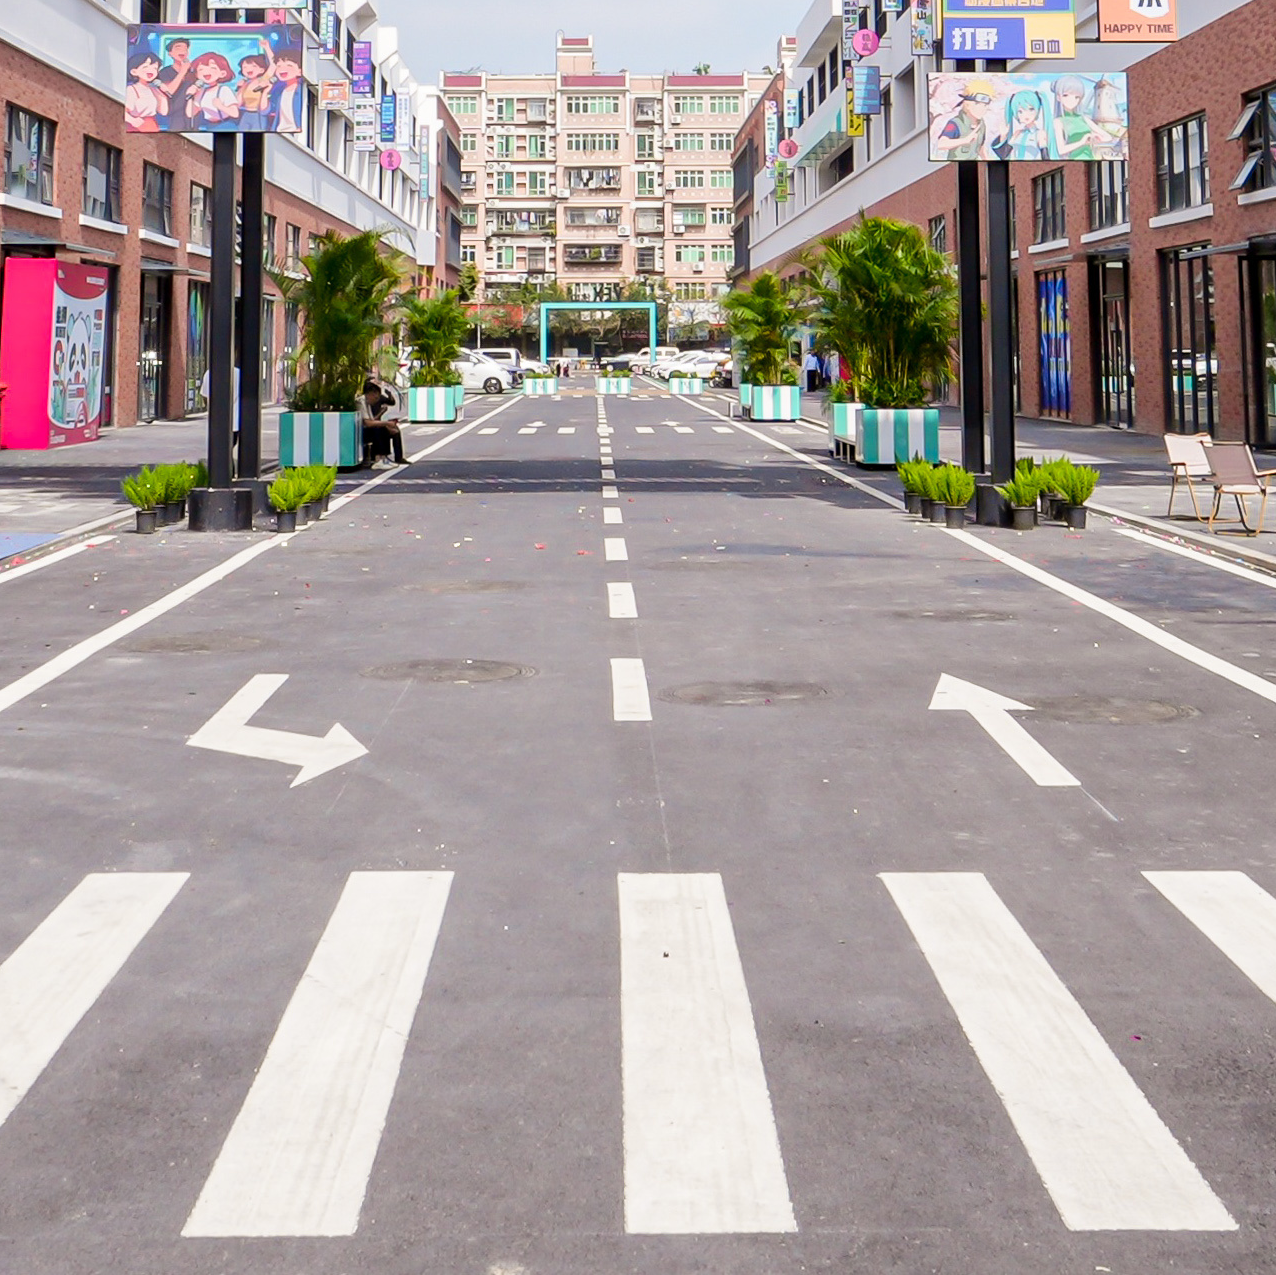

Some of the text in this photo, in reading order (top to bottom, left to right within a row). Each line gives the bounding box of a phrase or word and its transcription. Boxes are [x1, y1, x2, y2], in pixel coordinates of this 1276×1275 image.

[1103, 23, 1175, 34] HAPPY TIME
[952, 27, 998, 50] 打野
